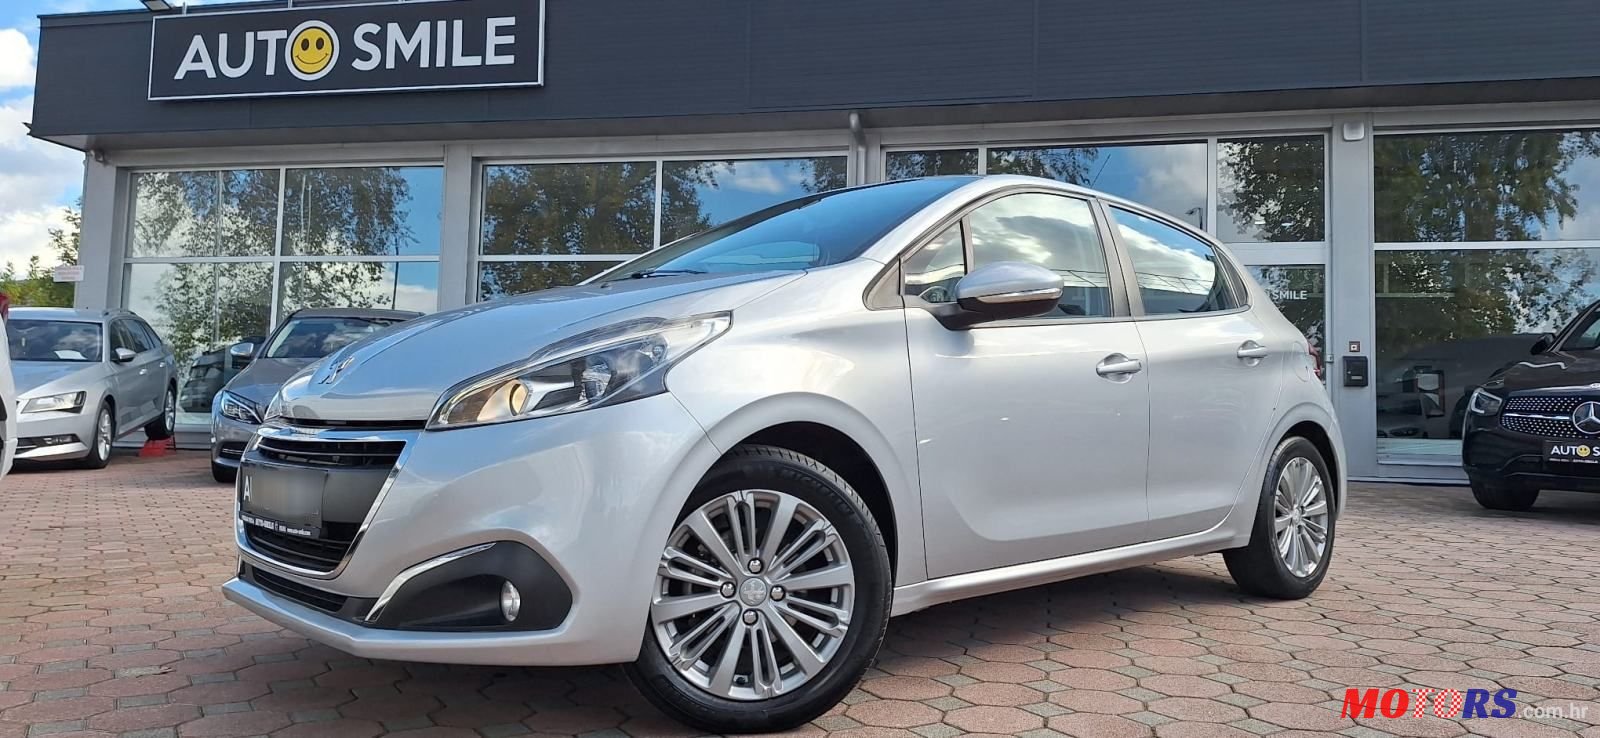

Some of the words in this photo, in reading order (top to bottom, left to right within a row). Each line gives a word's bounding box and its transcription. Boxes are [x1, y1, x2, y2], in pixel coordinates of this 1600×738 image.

[174, 19, 340, 81] AUTO
[351, 16, 516, 71] SMILE
[1272, 290, 1308, 300] SMILE
